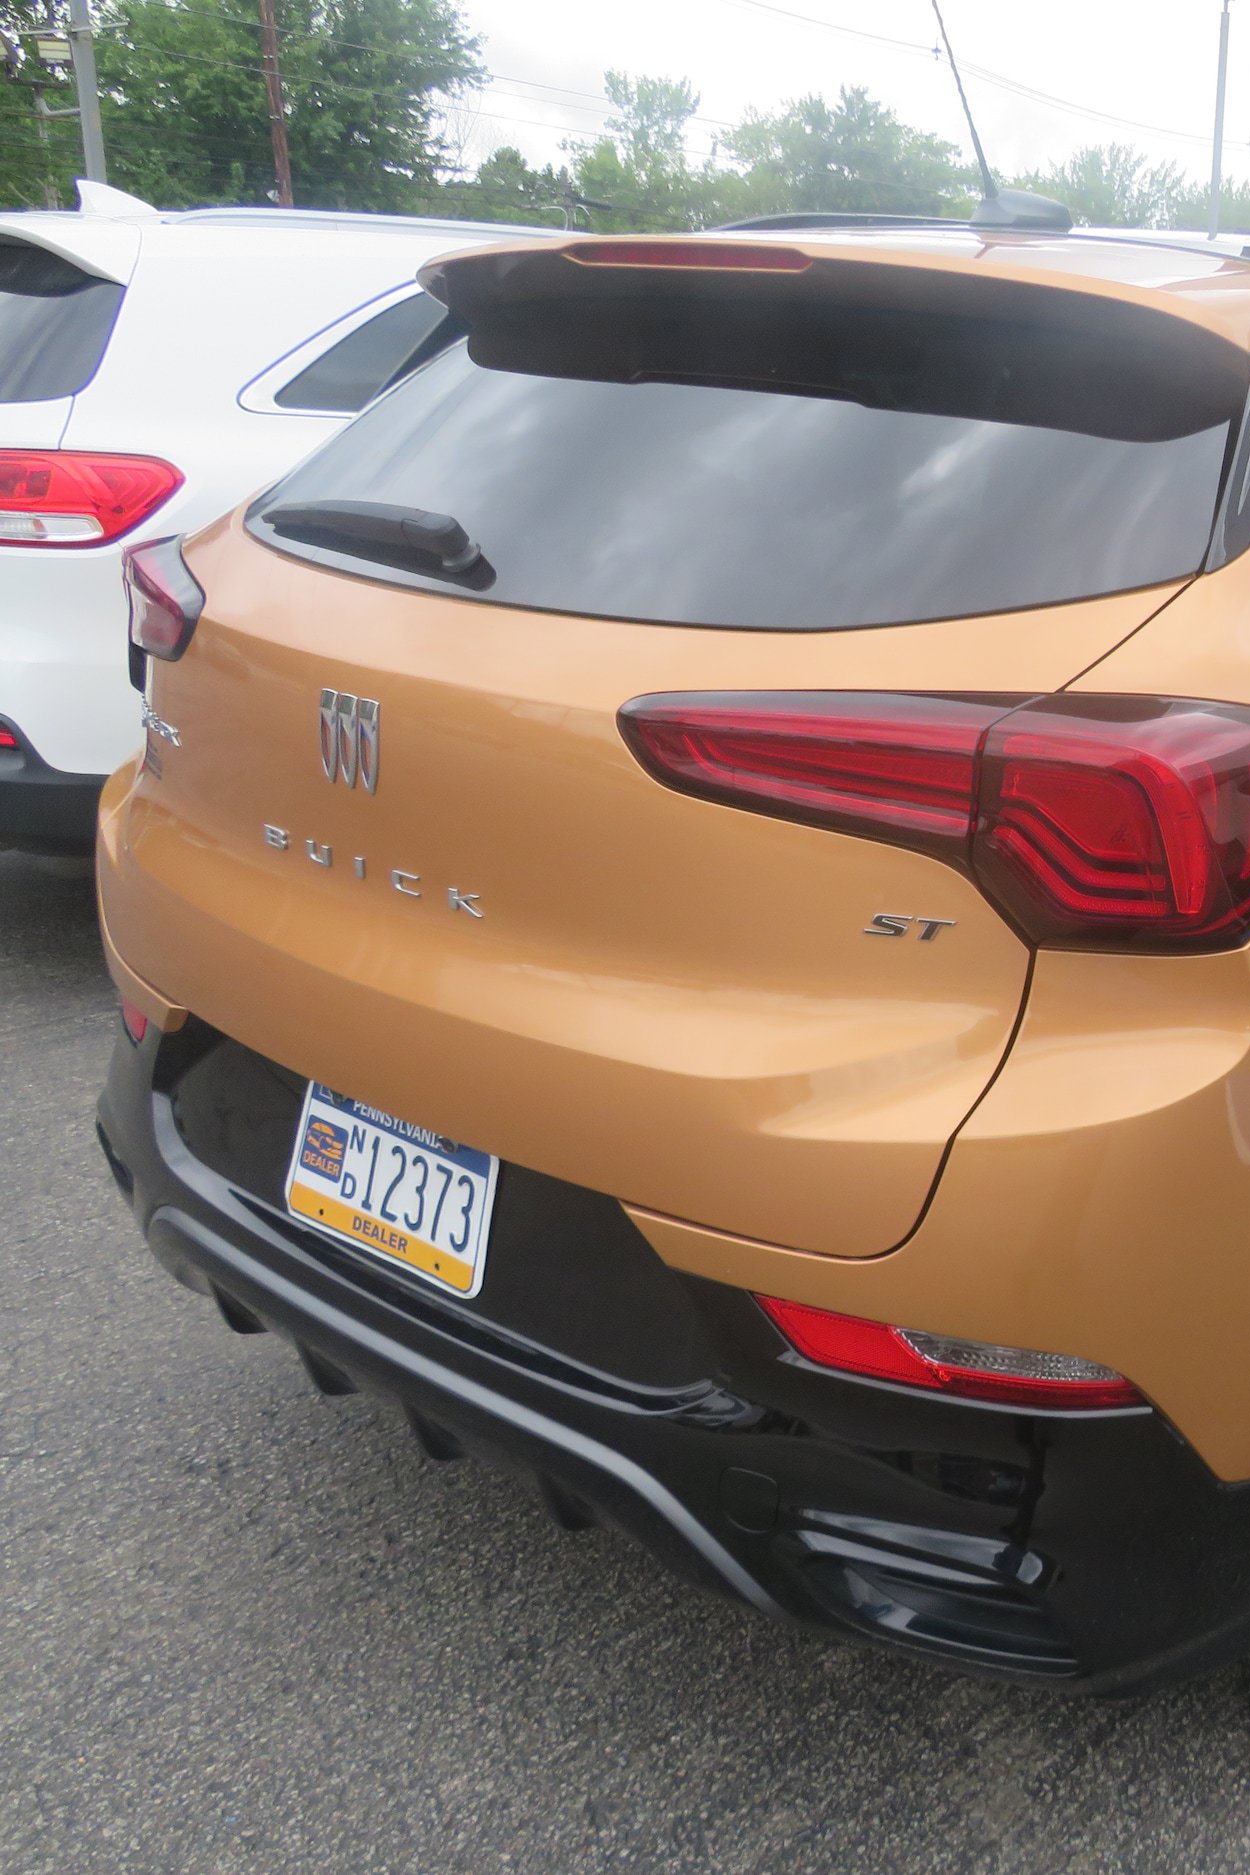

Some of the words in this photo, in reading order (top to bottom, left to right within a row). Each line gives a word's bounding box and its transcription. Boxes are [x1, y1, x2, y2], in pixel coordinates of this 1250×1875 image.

[262, 823, 486, 919] BUICK
[863, 913, 960, 942] ST
[303, 1151, 341, 1178] DEALER
[360, 1135, 476, 1254] 12373
[351, 1216, 410, 1254] DEALER
